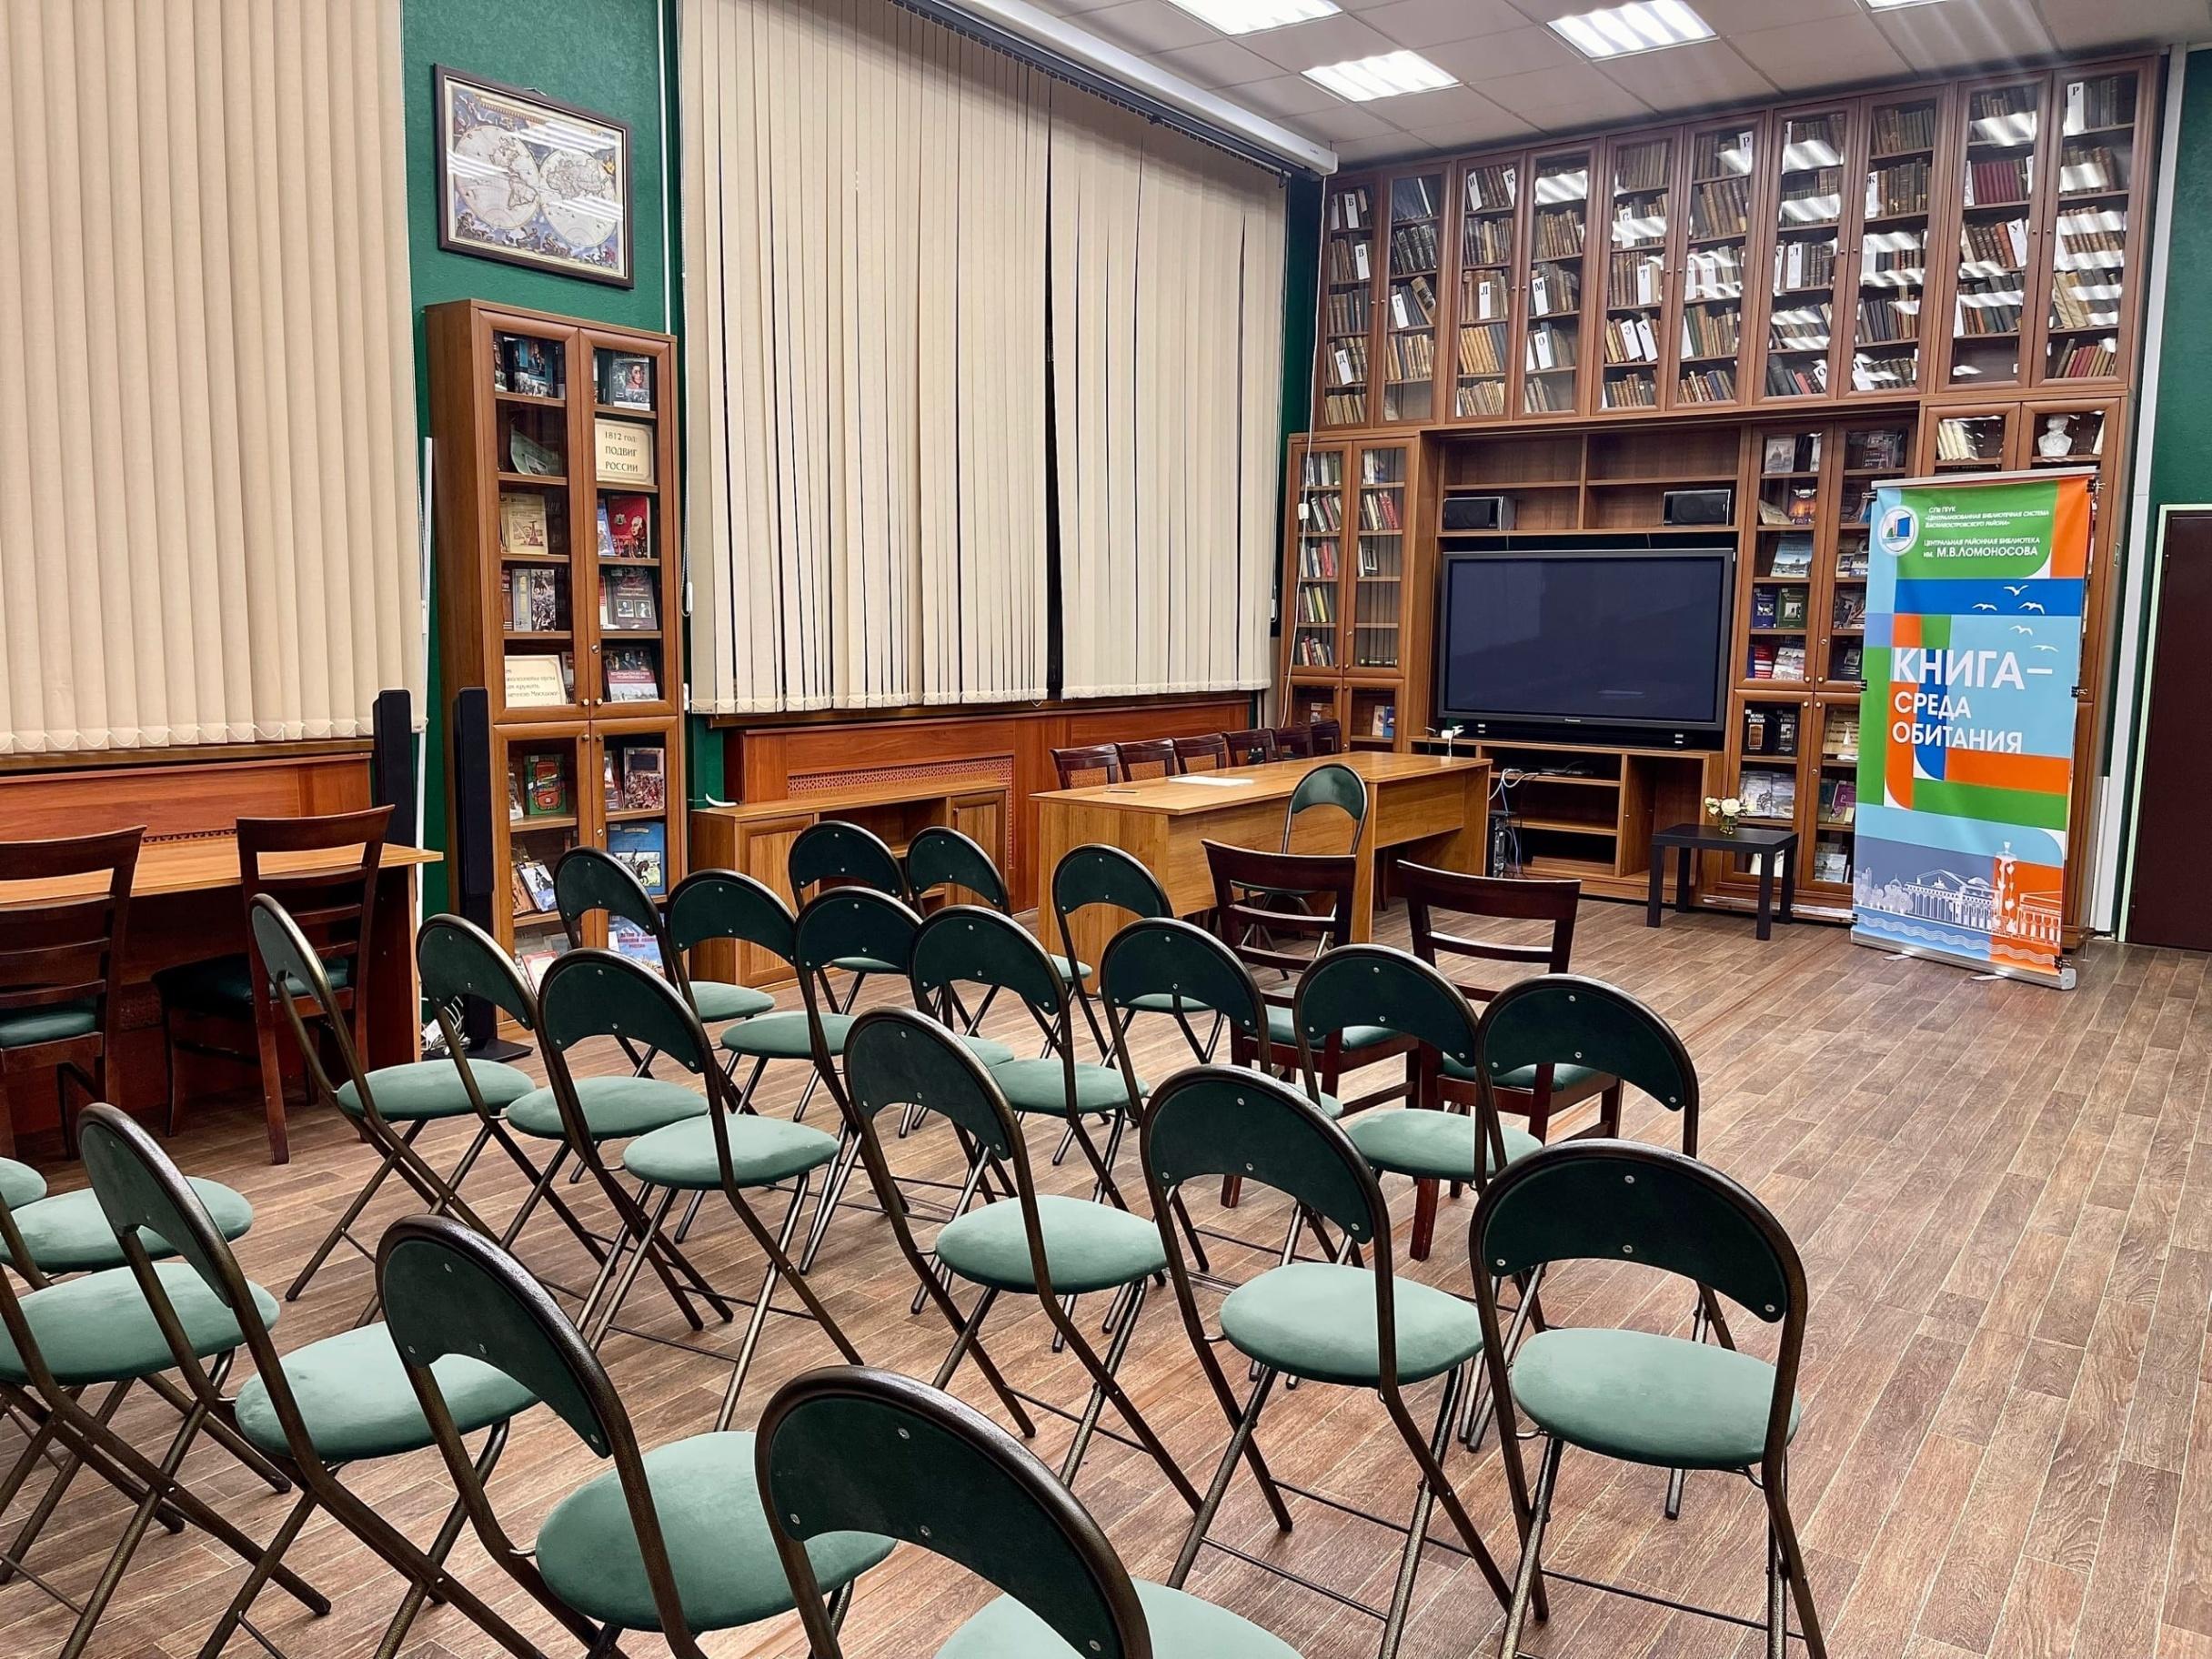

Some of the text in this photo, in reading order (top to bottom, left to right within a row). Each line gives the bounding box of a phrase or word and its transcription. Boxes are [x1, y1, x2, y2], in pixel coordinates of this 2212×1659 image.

[1506, 173, 1514, 184] К
[1358, 248, 1364, 257] В
[1640, 268, 1648, 279] Т
[1481, 285, 1489, 296] Л
[1534, 281, 1543, 292] М
[605, 431, 622, 440] 1812
[605, 446, 638, 457] ПОДВИГ
[605, 460, 638, 472] РОССИИ
[1924, 537, 2040, 547] ЦЕНТРАЛЬНАЯ РАЙОННАЯ БИБЛИОТЕКА
[1936, 547, 2037, 558] М.В.ЛОМОНОСОВА
[1894, 691, 1972, 721] СРЕДА
[1892, 720, 2023, 754] ОБИТАНИЯ
